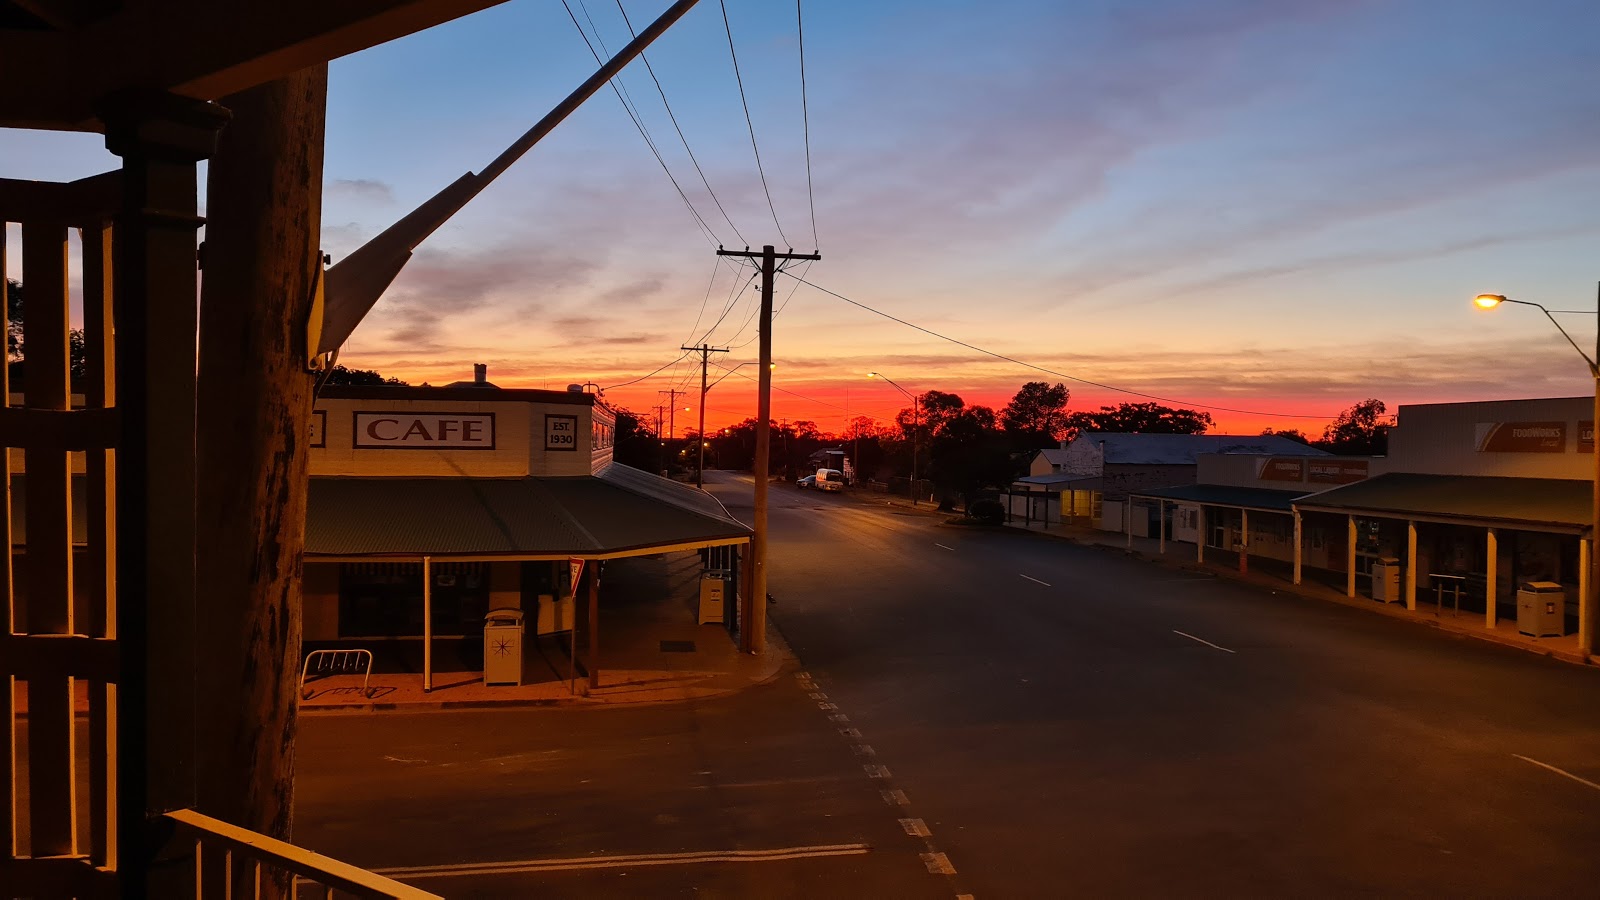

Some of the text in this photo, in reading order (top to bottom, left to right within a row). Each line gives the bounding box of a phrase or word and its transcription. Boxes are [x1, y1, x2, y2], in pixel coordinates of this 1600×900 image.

[366, 419, 482, 442] CAFE
[553, 422, 570, 431] EST.
[550, 434, 573, 444] 1930
